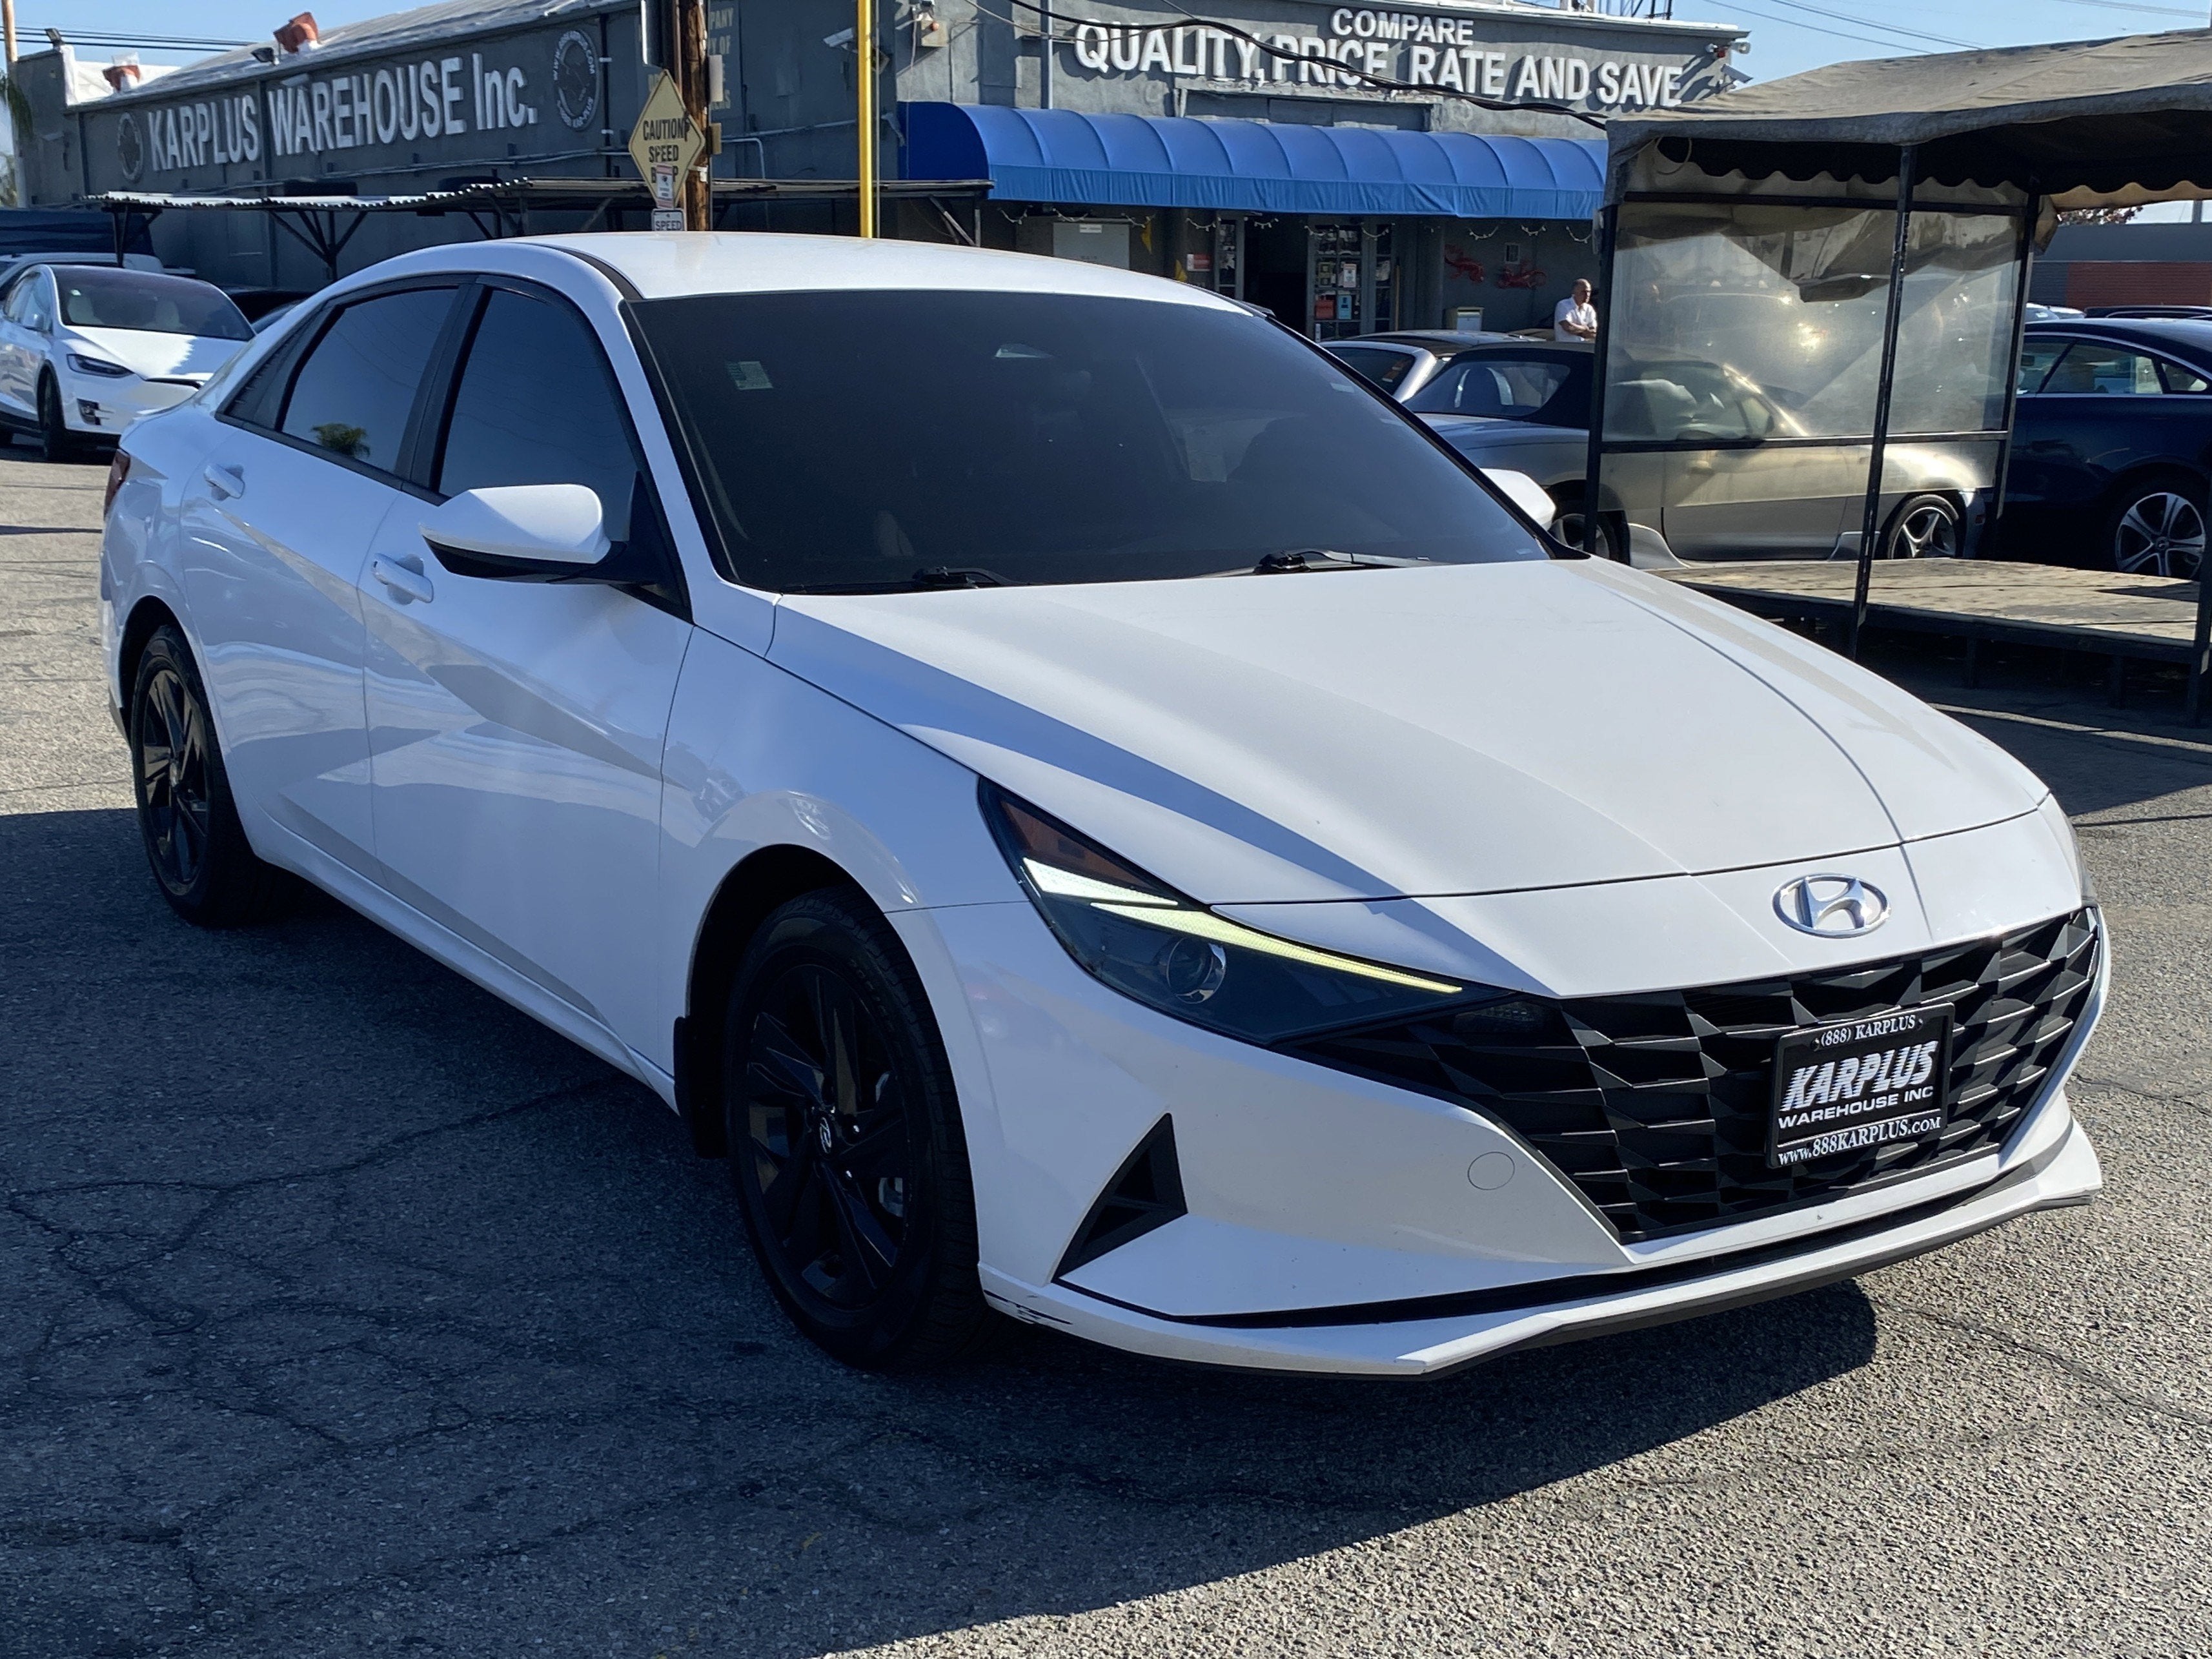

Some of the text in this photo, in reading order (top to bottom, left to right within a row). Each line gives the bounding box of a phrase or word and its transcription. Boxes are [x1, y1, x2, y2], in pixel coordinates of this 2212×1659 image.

[1331, 8, 1474, 45] COMPARE
[1074, 19, 1266, 87] QUALITY,
[1409, 45, 1505, 94] RATE
[1514, 55, 1589, 100] AND
[1596, 61, 1683, 107] SAVE
[148, 95, 258, 171] KARPLUS
[267, 59, 467, 156] WAREHOUSE
[472, 53, 538, 130] Inc.
[649, 145, 679, 163] SPEED
[651, 166, 678, 183] BP
[655, 220, 682, 231] SPEED
[1821, 1014, 1916, 1047] (888) KARPLUS
[1780, 1041, 1939, 1111] KARPLUS
[1778, 1086, 1934, 1129] WAREHOUSE INC
